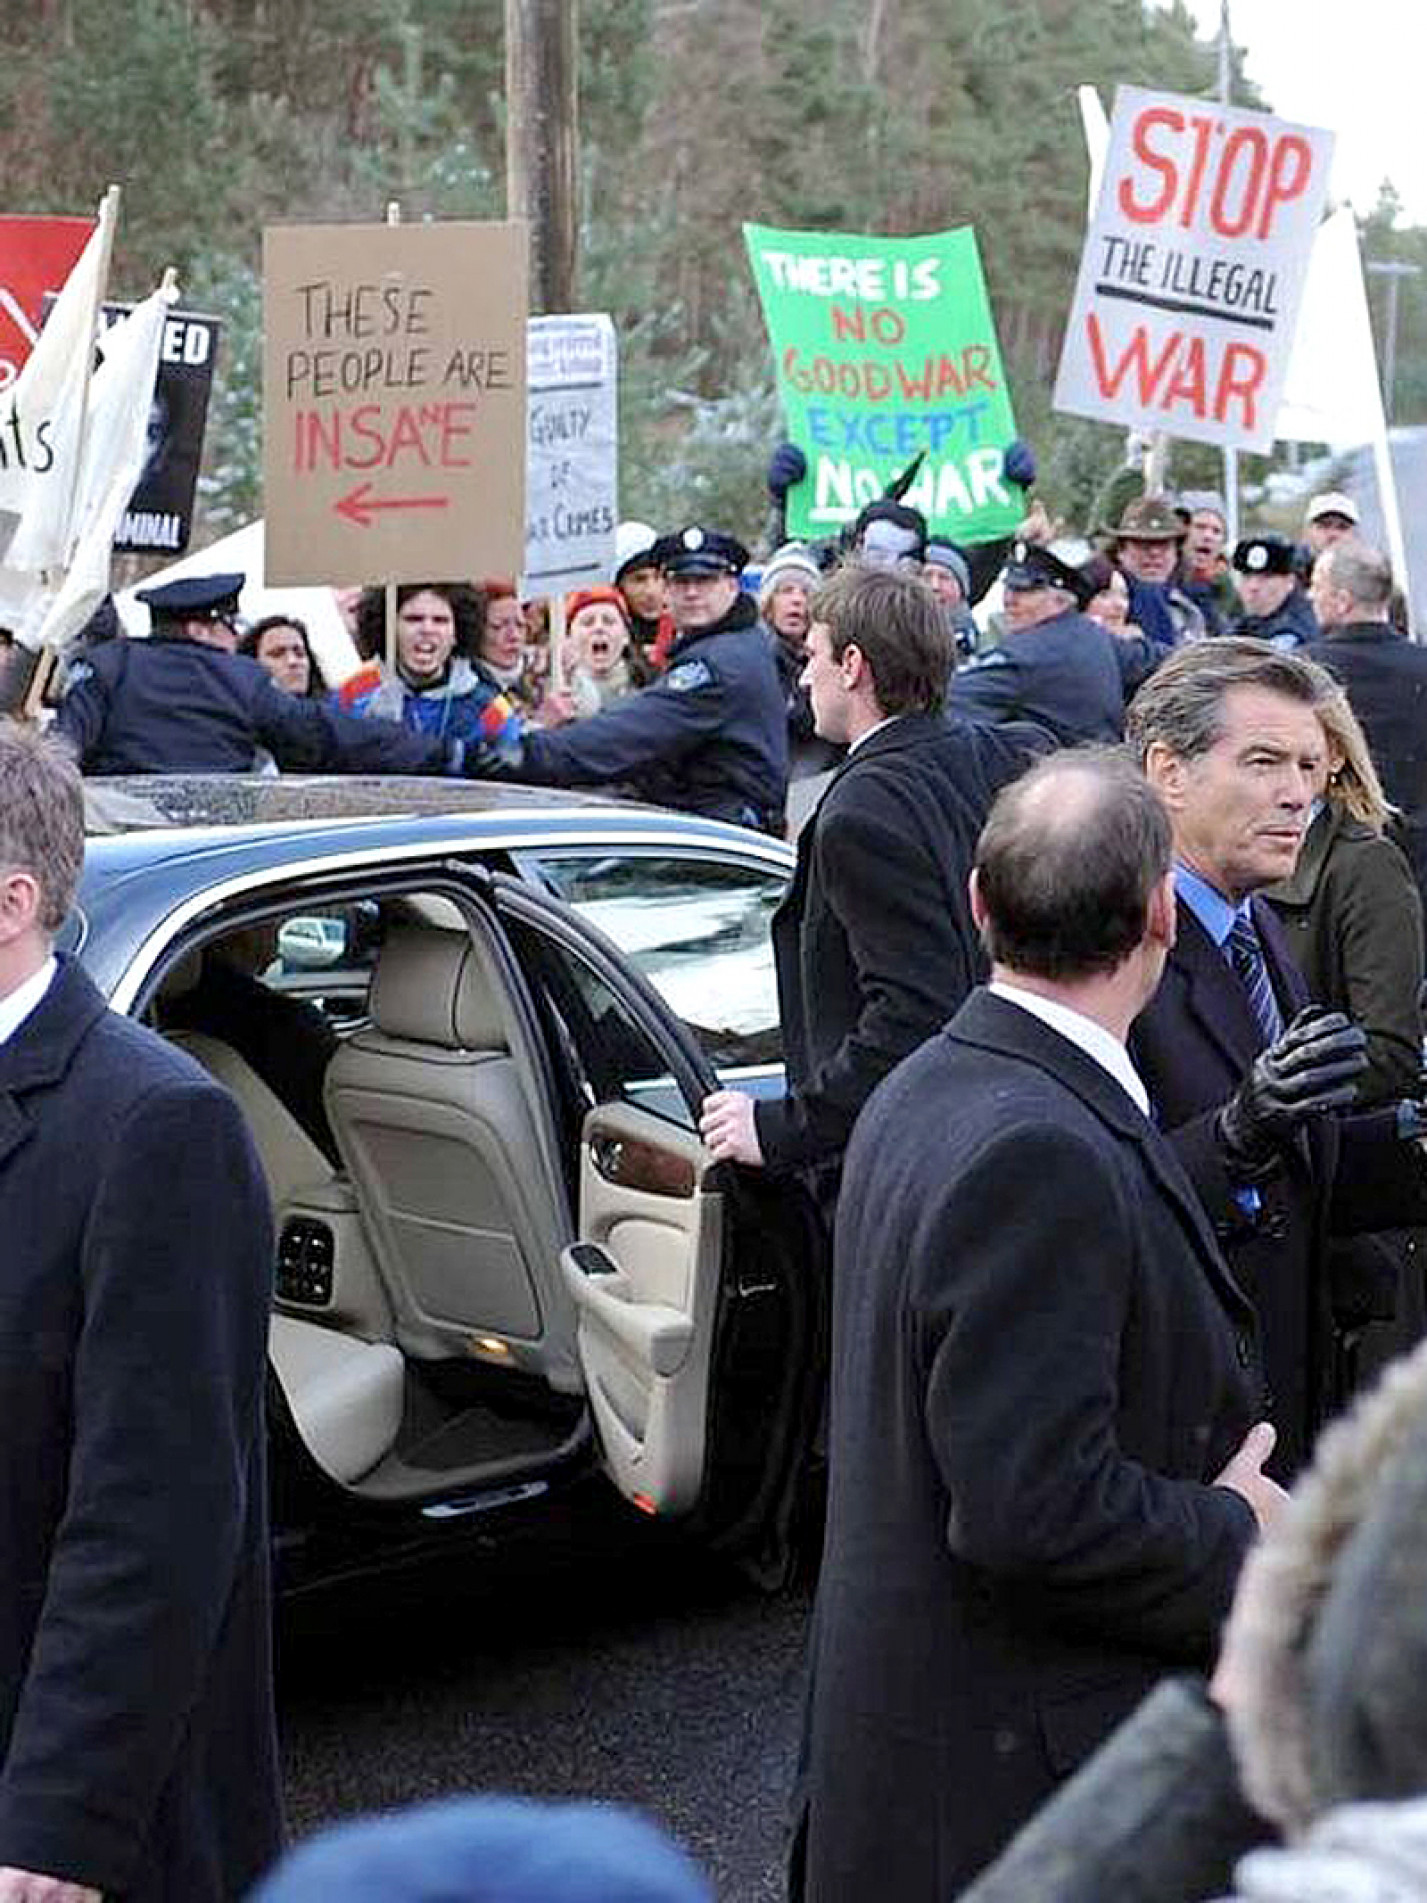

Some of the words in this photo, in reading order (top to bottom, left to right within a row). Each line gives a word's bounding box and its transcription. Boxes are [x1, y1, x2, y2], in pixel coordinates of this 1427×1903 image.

[1118, 107, 1312, 240] STOP
[760, 250, 886, 300] THERE
[892, 258, 941, 300] IS
[1102, 235, 1155, 286] THE
[1161, 249, 1277, 314] ILLEGAL
[296, 282, 433, 338] THESE
[830, 305, 905, 345] NO
[286, 347, 431, 401] PEOPLE
[443, 348, 513, 397] ARE
[783, 347, 892, 401] GOOD
[893, 344, 998, 402] WAR
[1086, 312, 1269, 431] WAR
[295, 402, 476, 472] INSANE
[806, 399, 989, 455] EXCEPT
